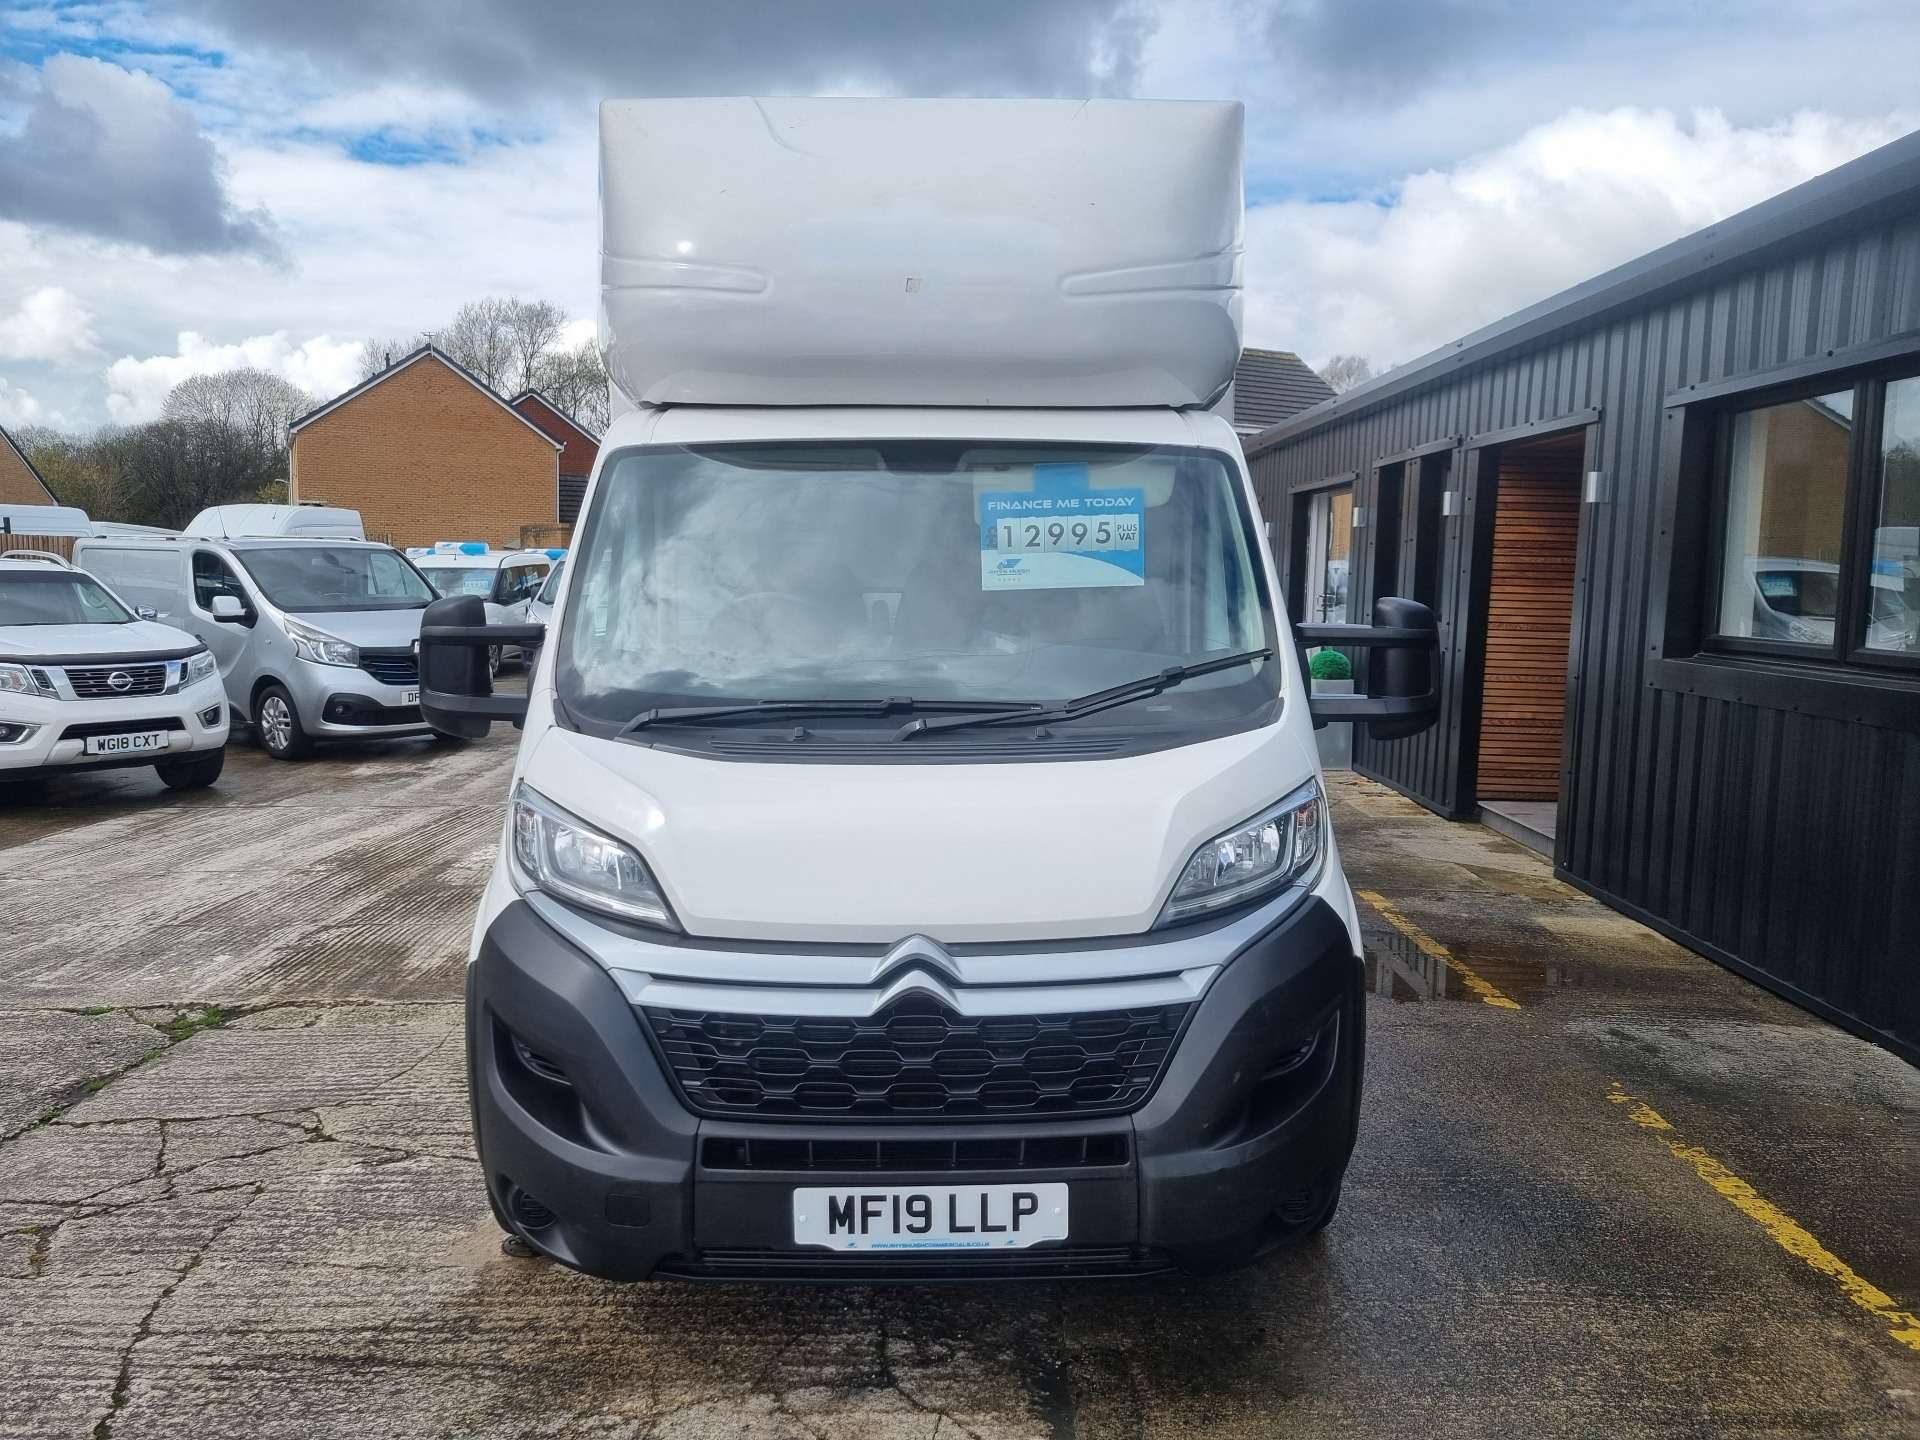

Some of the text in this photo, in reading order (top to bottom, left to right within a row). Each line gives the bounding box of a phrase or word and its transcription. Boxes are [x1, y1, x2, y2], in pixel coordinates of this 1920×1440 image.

[988, 497, 1136, 511] FINANCE ME TODAY
[1117, 523, 1138, 532] PLUS
[1118, 532, 1136, 541] VAT
[408, 692, 419, 702] DF
[97, 734, 160, 751] WG18 CXT
[828, 1191, 1039, 1235] MF19 LLP
